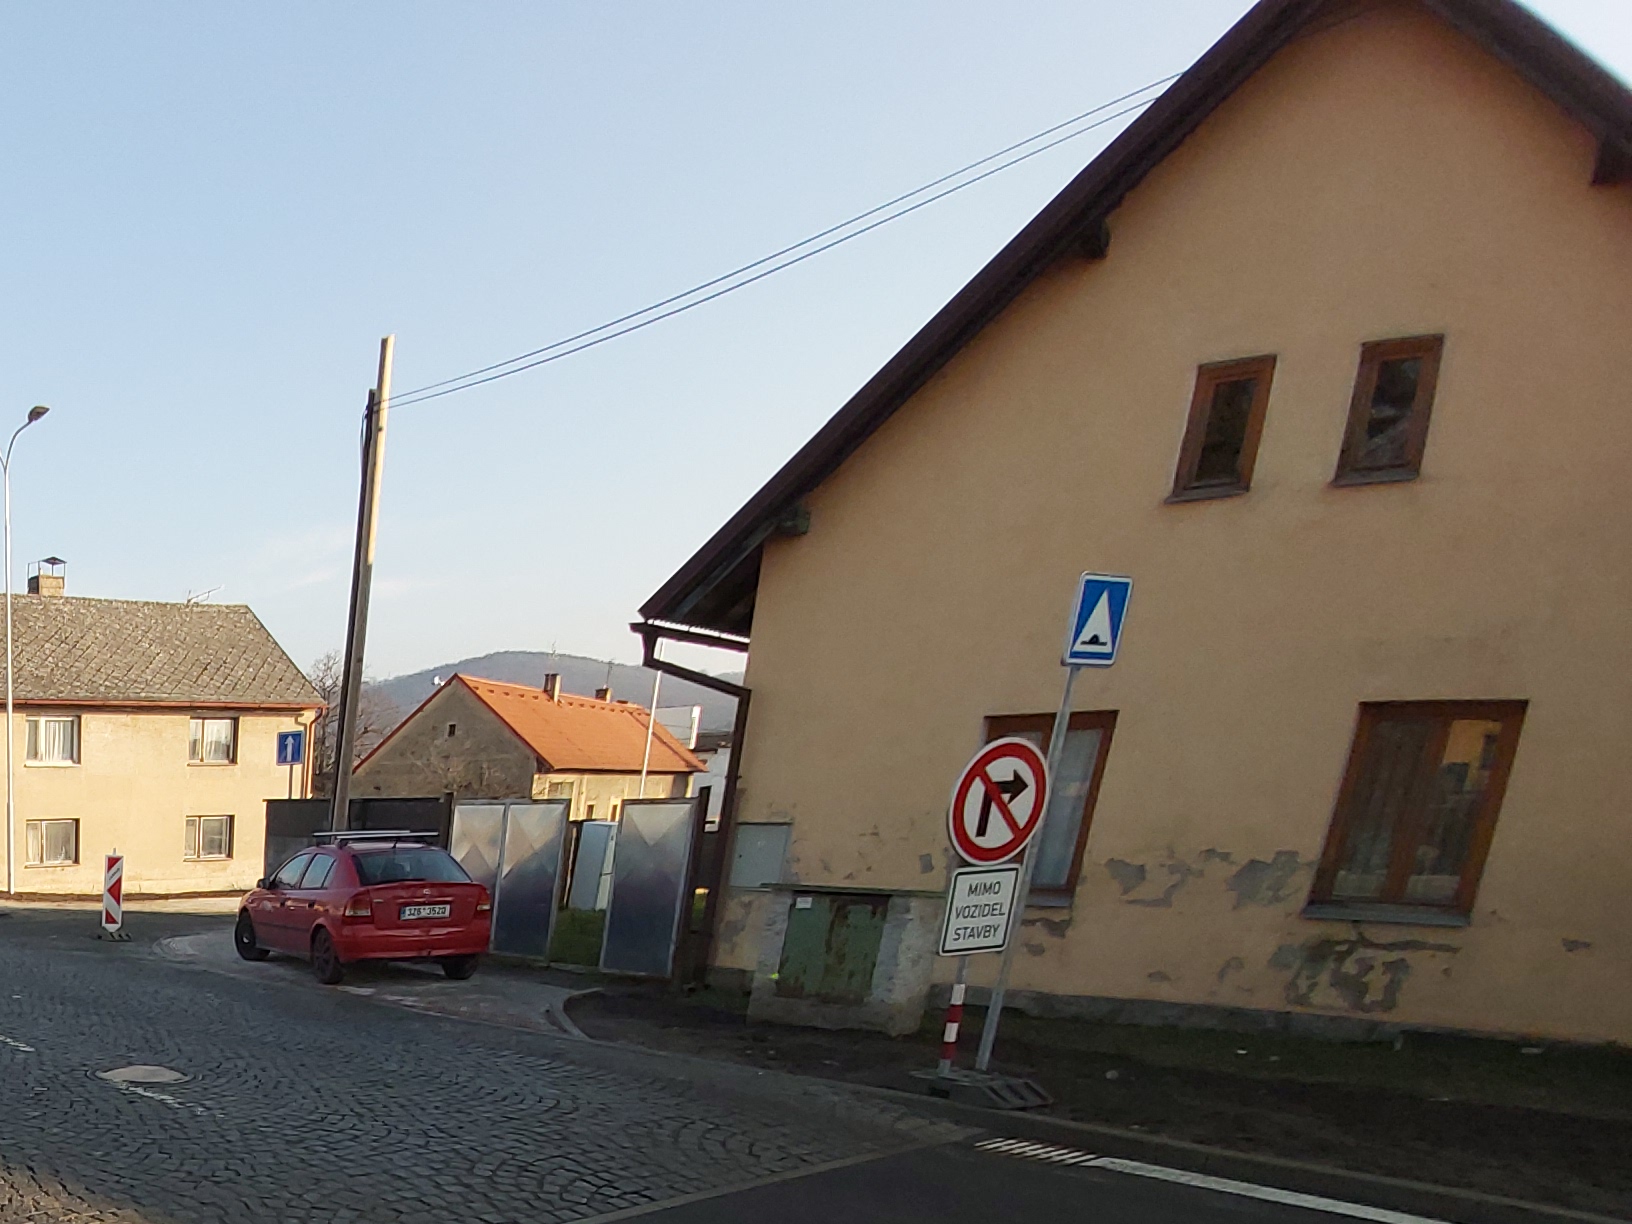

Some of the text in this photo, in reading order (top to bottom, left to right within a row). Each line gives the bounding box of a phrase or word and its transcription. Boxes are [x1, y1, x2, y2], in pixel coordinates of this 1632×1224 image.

[967, 881, 1002, 898] MIMO
[955, 902, 1006, 920] VOZIDEL
[952, 924, 1001, 942] STAVBY
